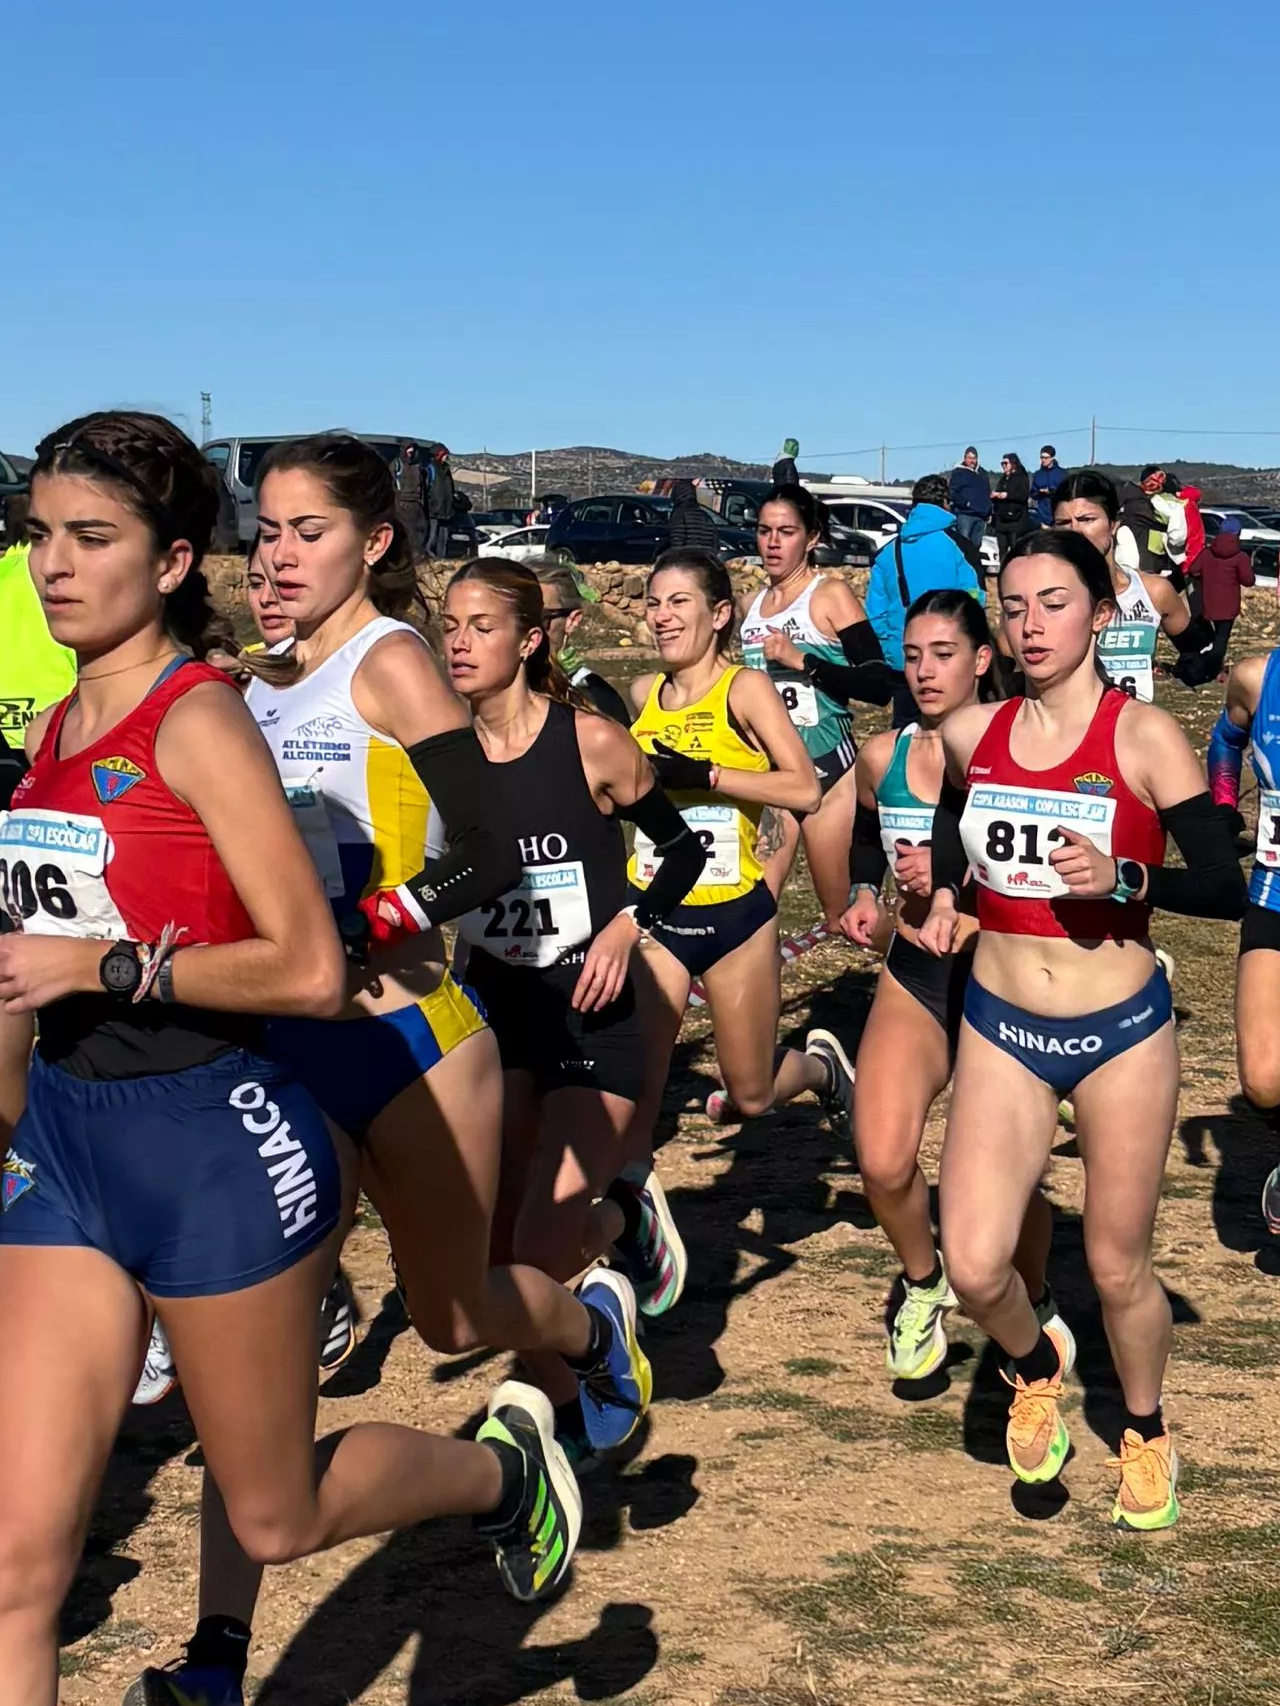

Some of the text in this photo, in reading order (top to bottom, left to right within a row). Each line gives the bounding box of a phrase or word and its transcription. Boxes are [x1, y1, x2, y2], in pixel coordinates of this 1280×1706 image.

[480, 897, 560, 938] 221
[998, 1021, 1103, 1057] HINACO
[228, 1081, 318, 1239] HINACO
